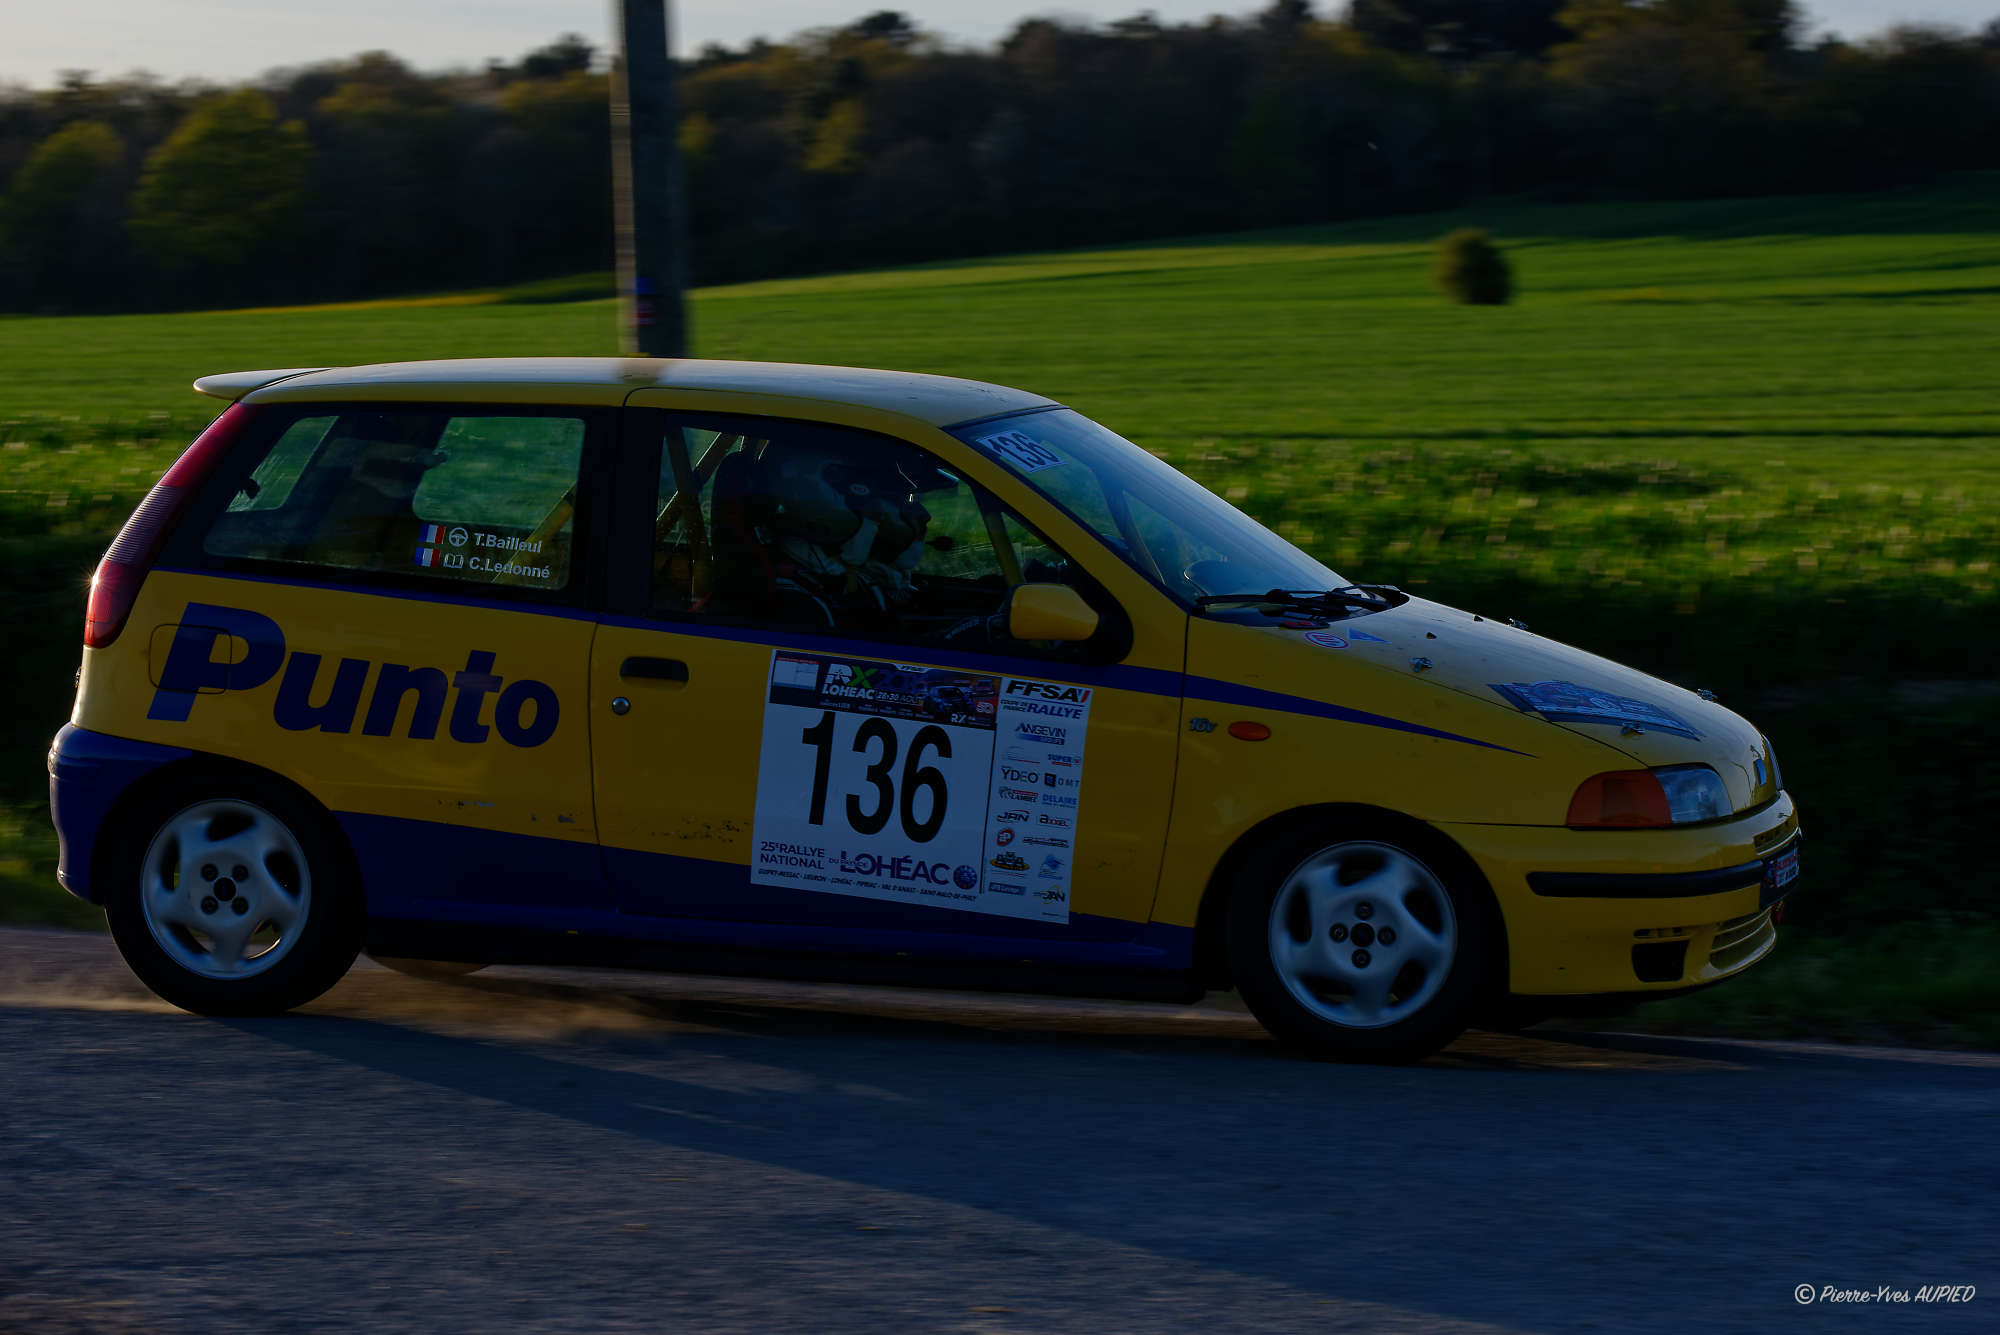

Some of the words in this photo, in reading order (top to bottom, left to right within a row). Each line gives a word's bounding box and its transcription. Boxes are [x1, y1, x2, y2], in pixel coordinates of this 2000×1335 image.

[988, 432, 1059, 469] 136
[474, 533, 543, 553] T.Bailleul
[469, 557, 550, 579] C.Ledonné
[147, 602, 560, 748] Punto
[821, 683, 875, 701] LOHEAC
[1006, 680, 1078, 703] FFSA
[1027, 703, 1082, 719] RALLYE
[1015, 722, 1066, 738] ANGEVIN
[802, 711, 952, 843] 136
[1001, 767, 1039, 784] YDEO
[760, 854, 825, 870] NATIONAL
[840, 850, 949, 884] LOHÉAC
